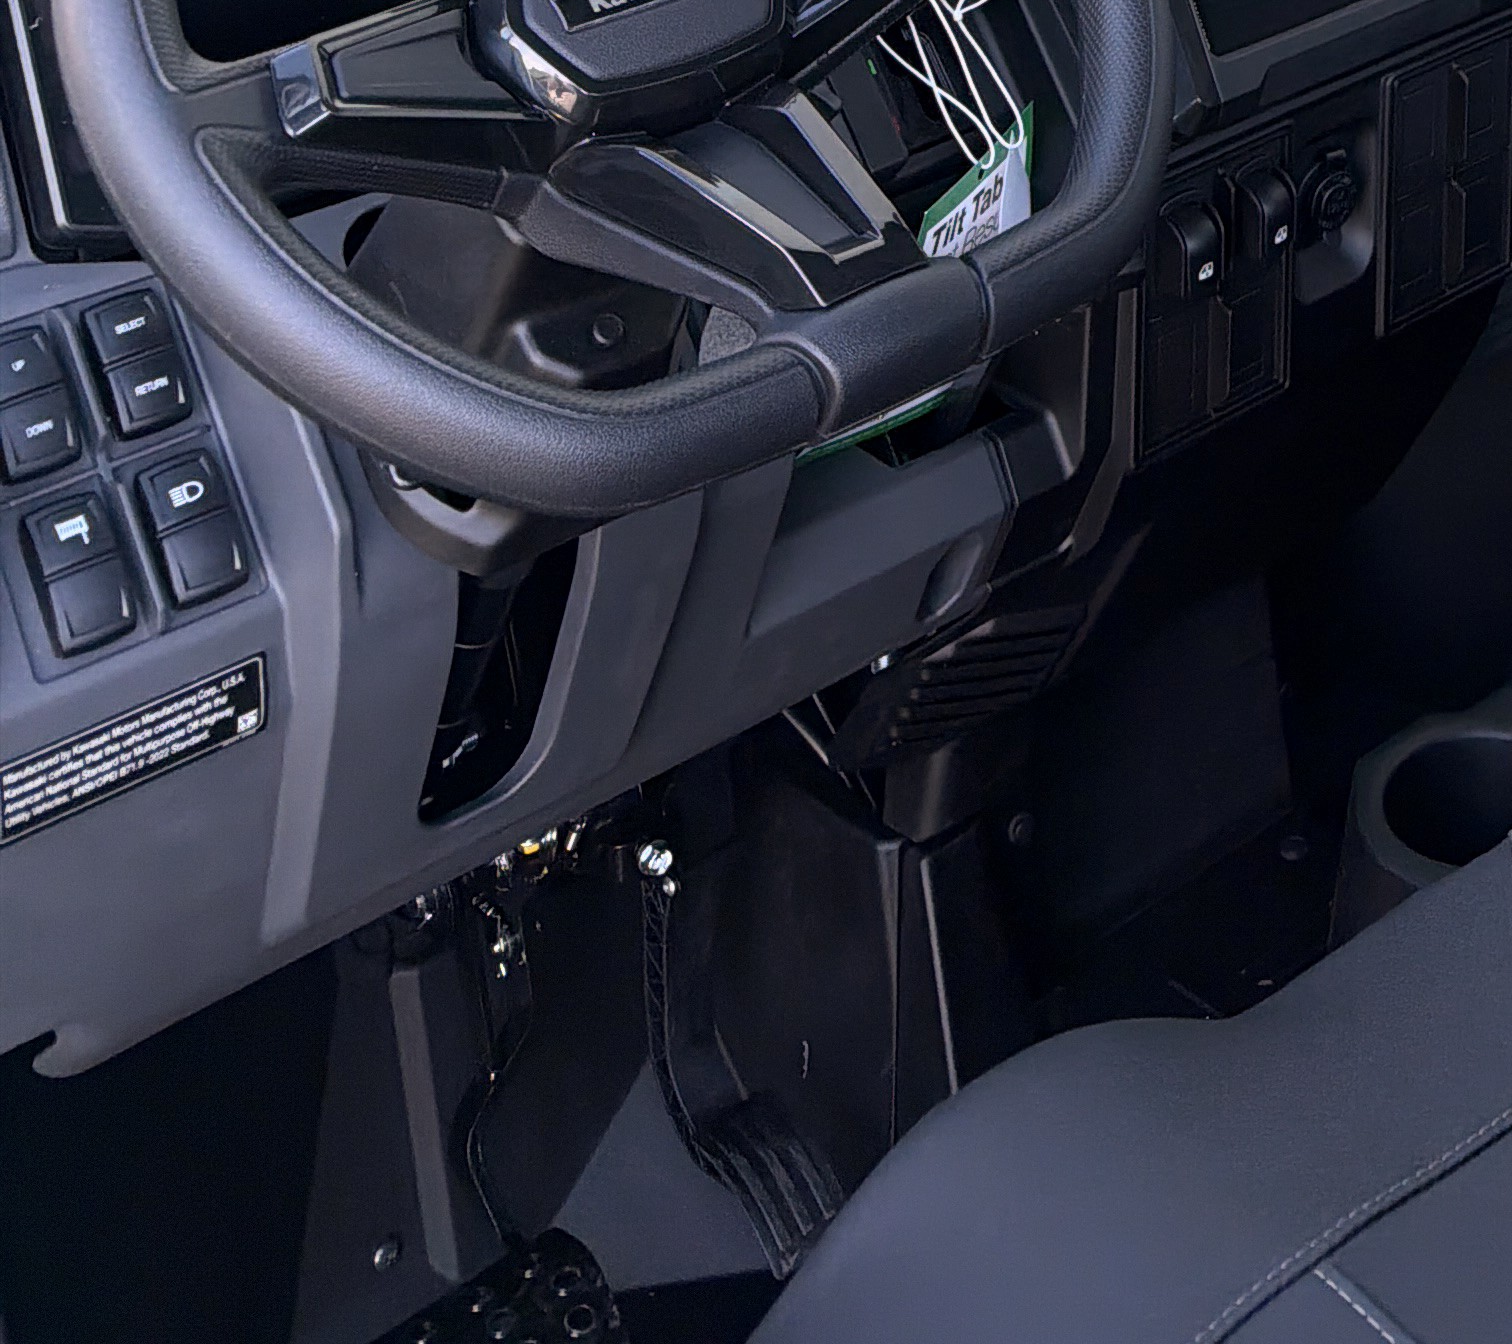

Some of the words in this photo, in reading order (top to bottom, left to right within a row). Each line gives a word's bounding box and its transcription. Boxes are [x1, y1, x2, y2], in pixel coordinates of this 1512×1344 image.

[932, 207, 966, 256] Tilt
[114, 316, 146, 334] SELECT
[11, 359, 25, 372] UP
[135, 375, 169, 396] RETURN
[26, 419, 53, 438] DOWN
[3, 754, 60, 785] Manufactured
[60, 750, 71, 762] by
[72, 733, 110, 756] Kawasaki
[111, 720, 140, 738] Motors
[141, 695, 196, 725] Manufacturing
[4, 774, 47, 800] Kawasaki
[48, 759, 84, 780] certifies
[85, 750, 103, 764] that
[104, 743, 120, 756] this
[122, 729, 152, 748] vehicle
[154, 711, 193, 734] complies
[194, 701, 212, 716] with
[214, 693, 229, 708] the
[4, 790, 44, 815] American
[45, 773, 80, 796] National
[82, 756, 119, 780] Standard
[120, 752, 132, 763] for
[133, 728, 186, 757] Multipurpose
[186, 706, 235, 734] Off-Highway
[5, 811, 31, 828] Utility
